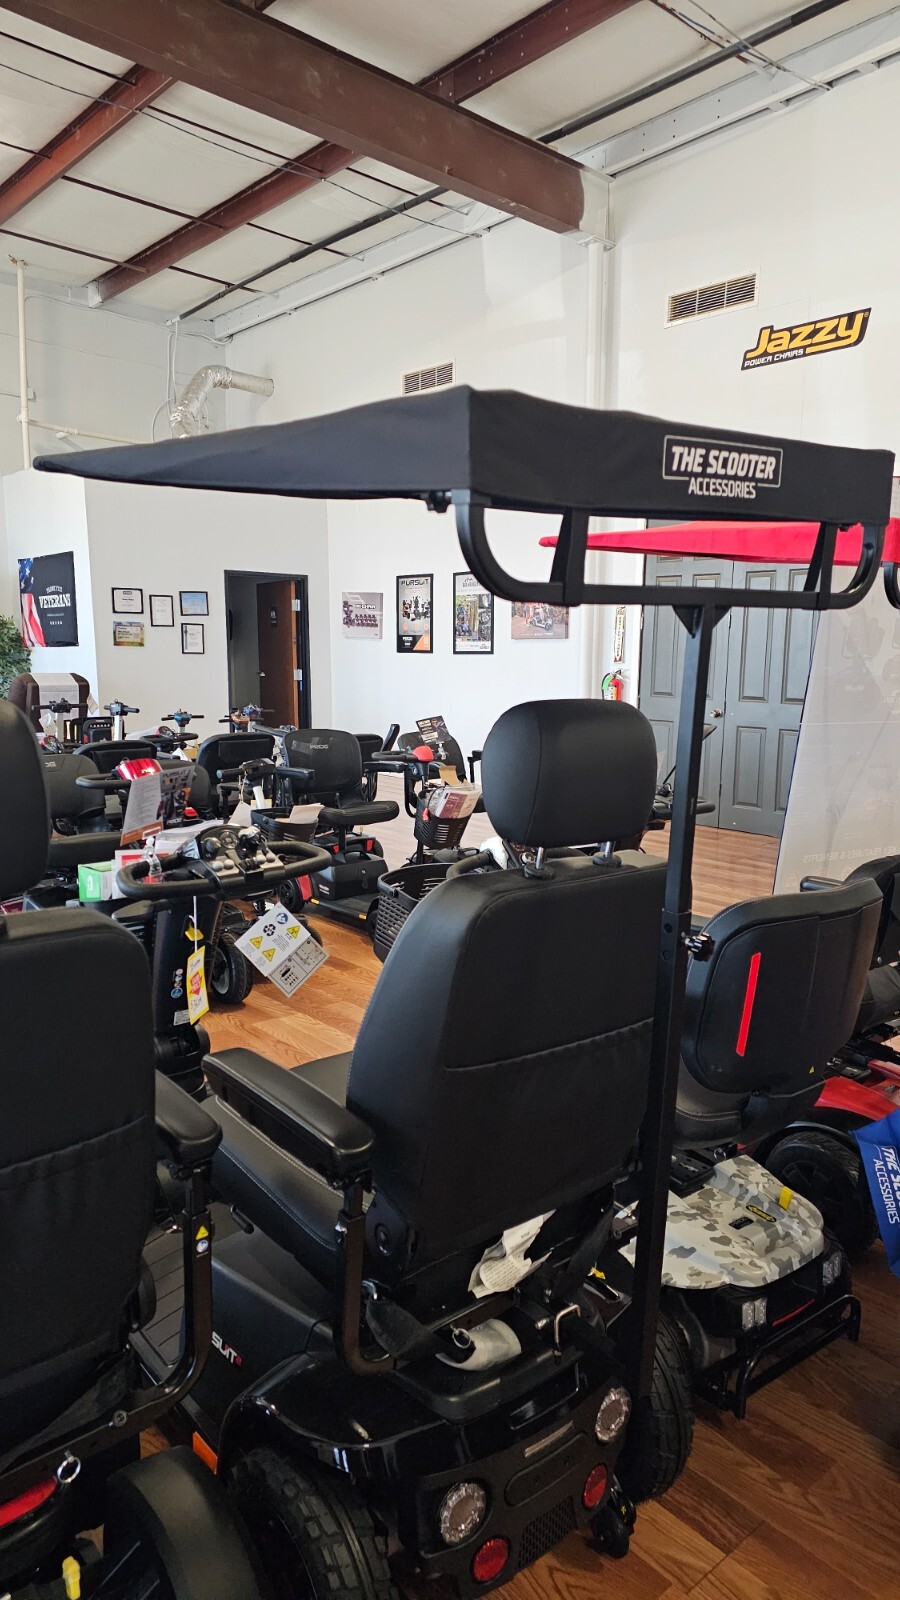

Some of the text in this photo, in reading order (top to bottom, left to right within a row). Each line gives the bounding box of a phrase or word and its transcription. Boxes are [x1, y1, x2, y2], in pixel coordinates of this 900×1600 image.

[744, 348, 804, 368] POWER CHAIRS
[671, 446, 777, 480] THE SCOOTER
[688, 477, 757, 499] ACCESSORIES
[38, 593, 71, 609] VETERANS
[873, 1158, 900, 1224] ACCESSORIES
